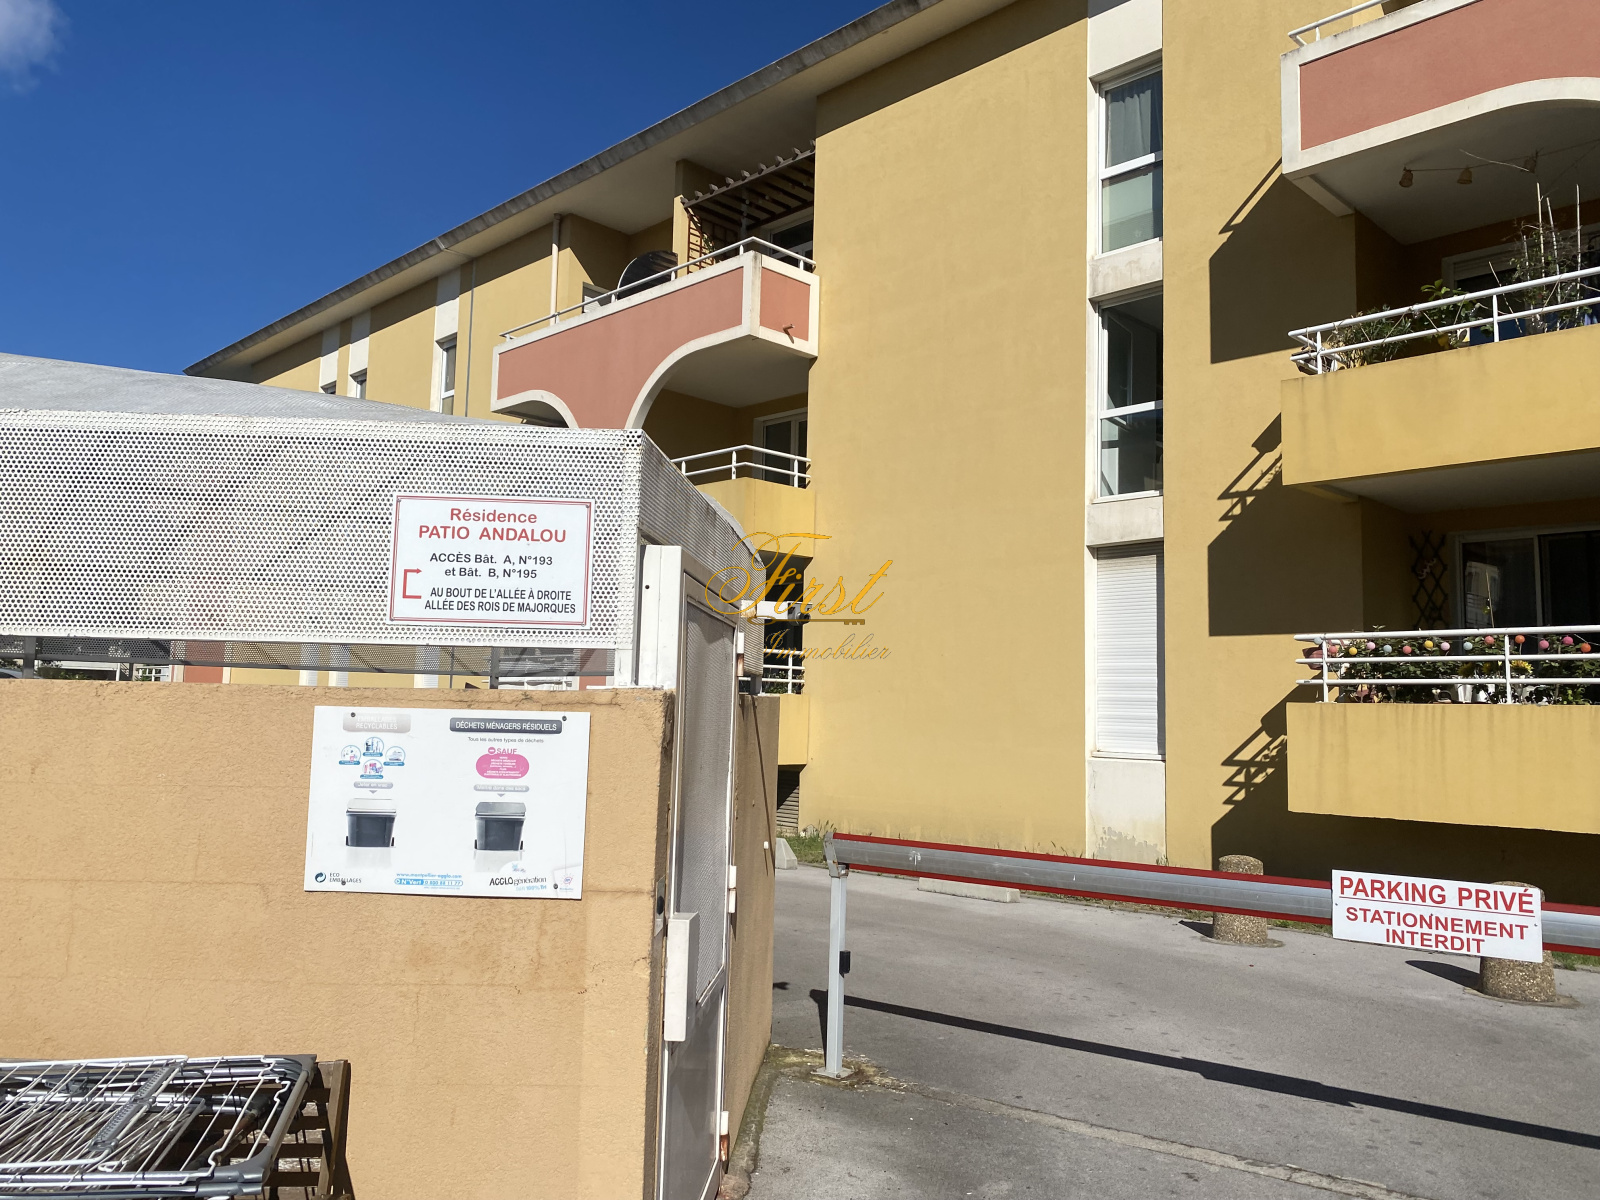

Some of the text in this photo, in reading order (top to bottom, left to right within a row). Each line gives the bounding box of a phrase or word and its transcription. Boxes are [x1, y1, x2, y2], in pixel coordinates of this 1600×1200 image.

[450, 508, 537, 523] Résidence
[419, 525, 566, 542] PATIO ANDALOU
[430, 552, 553, 565] ACCÈS Bât. A, N°193
[445, 568, 537, 578] et Bât. B, N°195
[430, 587, 571, 600] AU BOUT DE L'ALLÉE À DROITE
[425, 598, 575, 614] ALLÉE DES ROIS DE MAJORQUES
[456, 720, 557, 731] DÉCHETS MÉNAGERS RÉSIDUELS
[1340, 877, 1534, 914] PARKING PRIVÉ
[1346, 907, 1529, 940] STATIONNEMENT
[1386, 929, 1485, 953] INTERDIT
